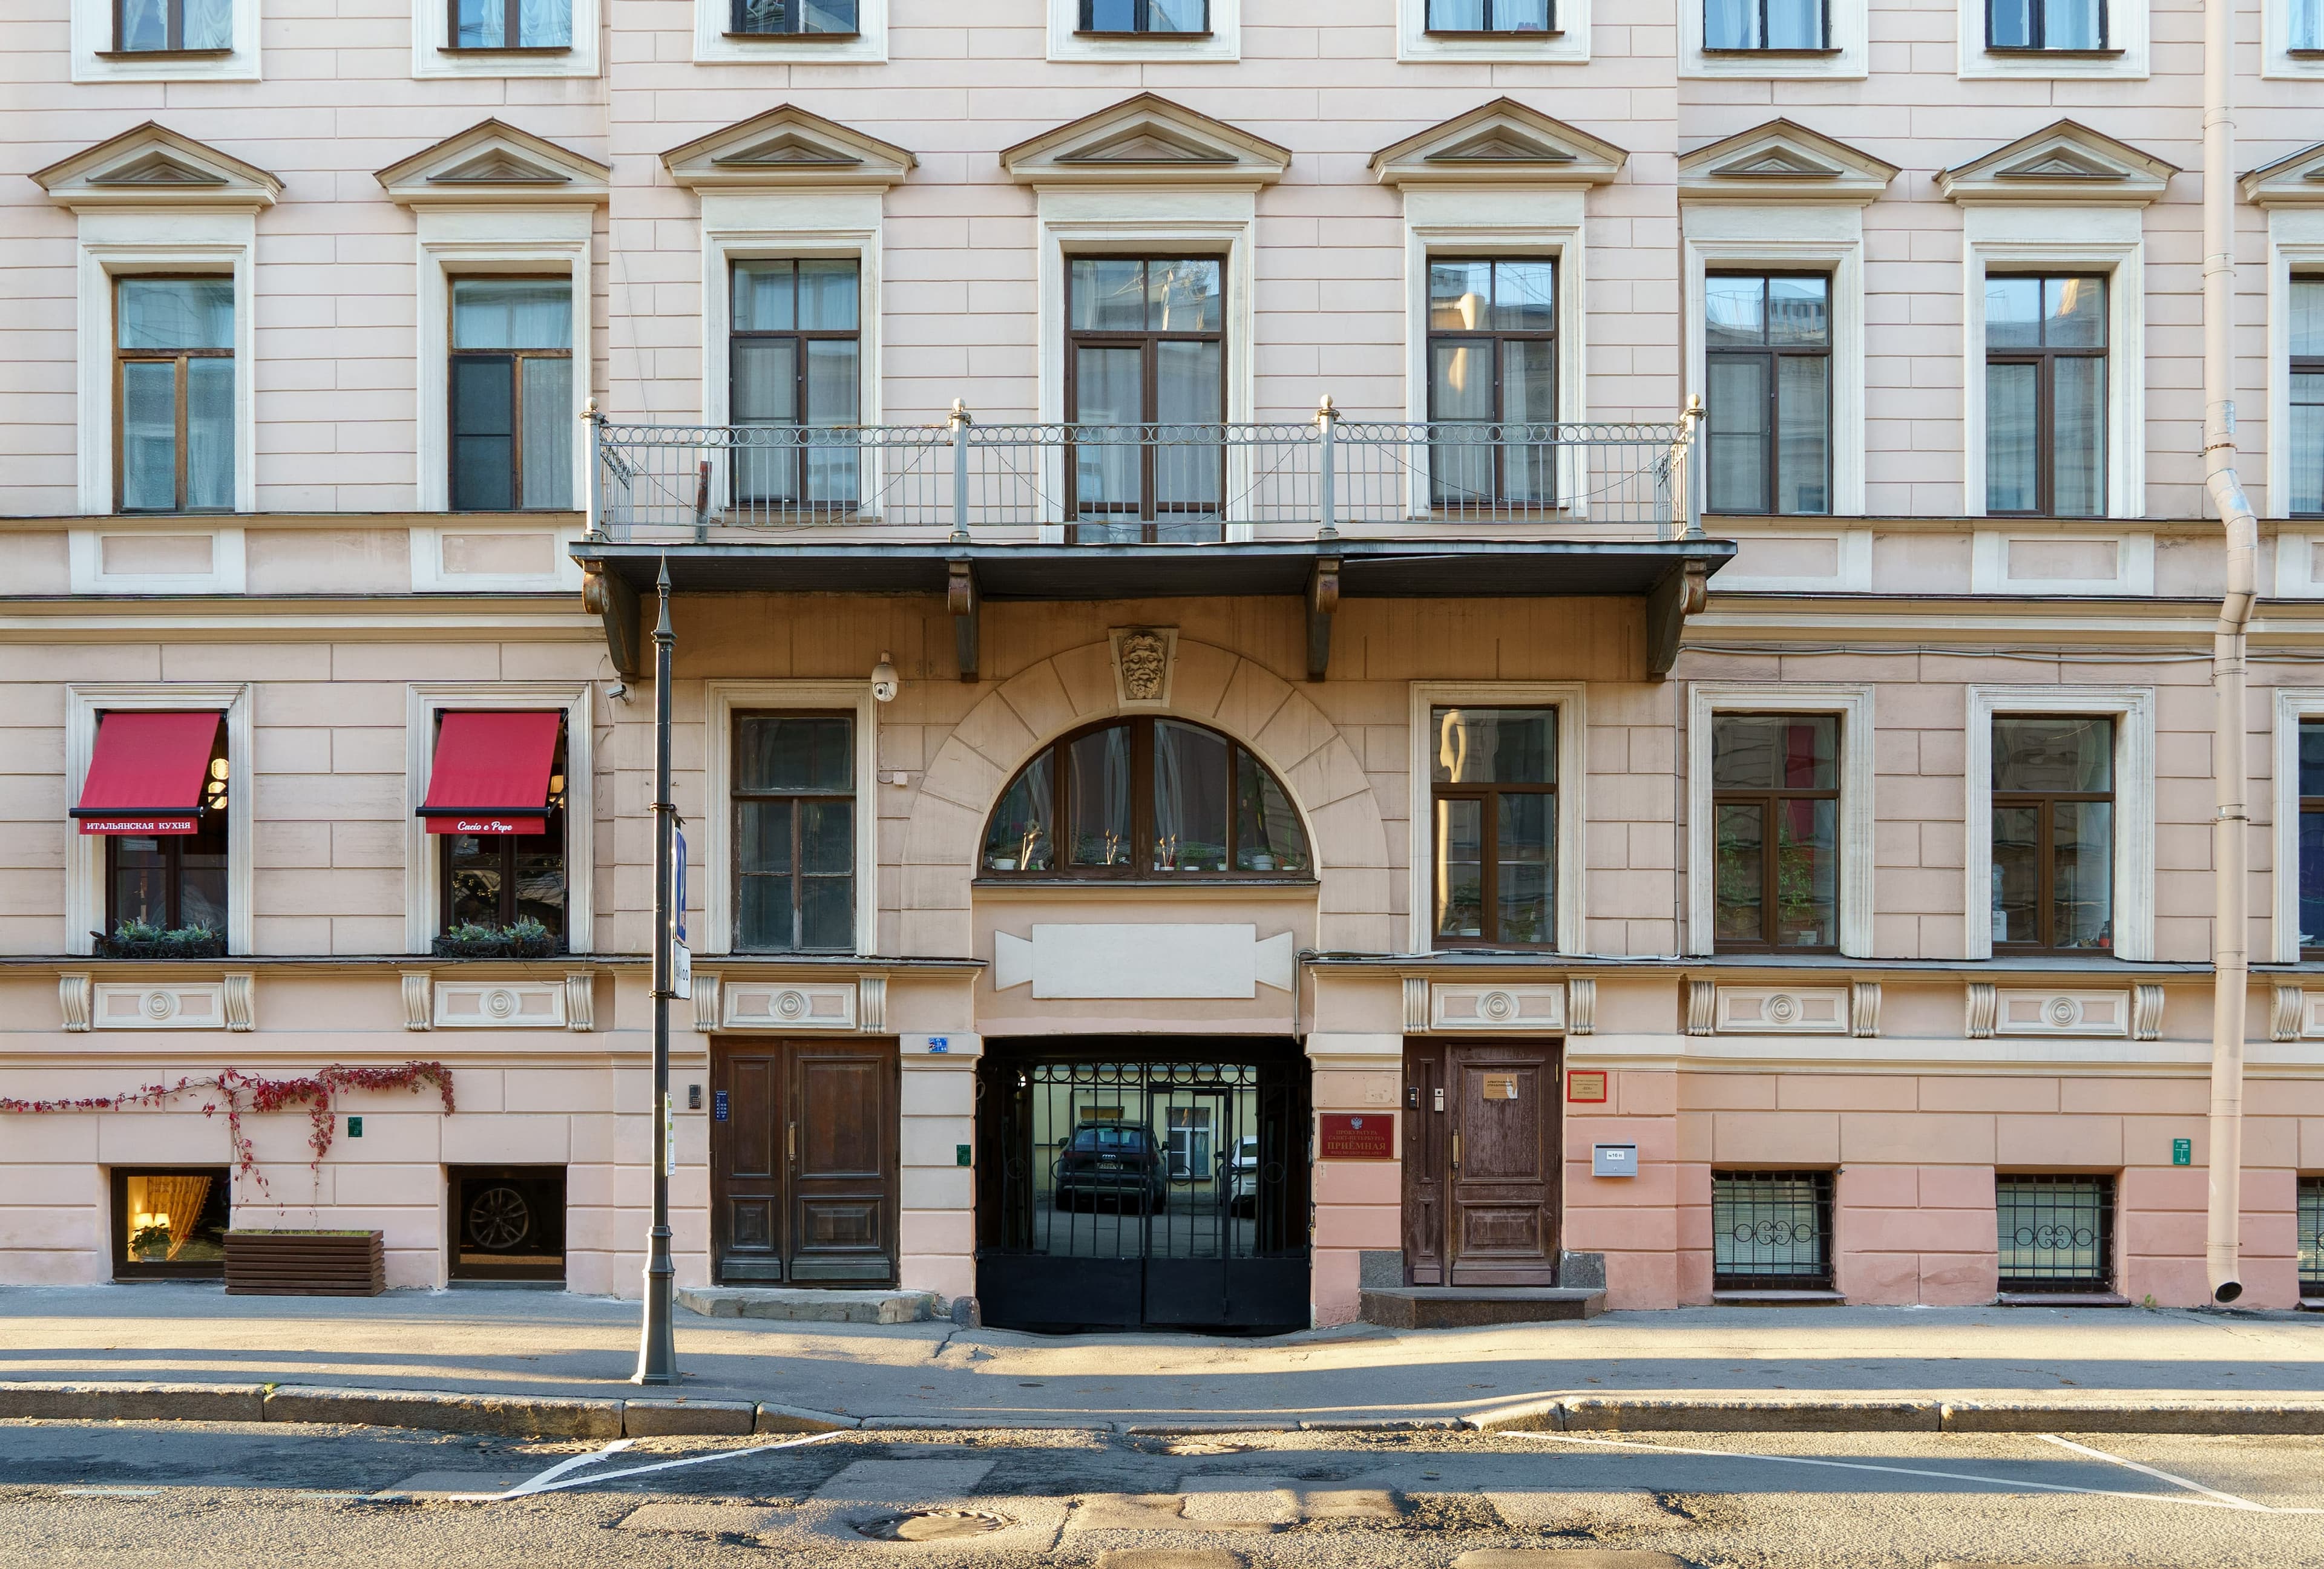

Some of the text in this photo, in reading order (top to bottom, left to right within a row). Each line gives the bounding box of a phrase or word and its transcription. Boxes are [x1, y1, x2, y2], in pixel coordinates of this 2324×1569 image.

[458, 821, 481, 830] Cacio
[491, 821, 512, 833] Pepe
[1327, 1141, 1385, 1150] ПРИЁМНАЯ
